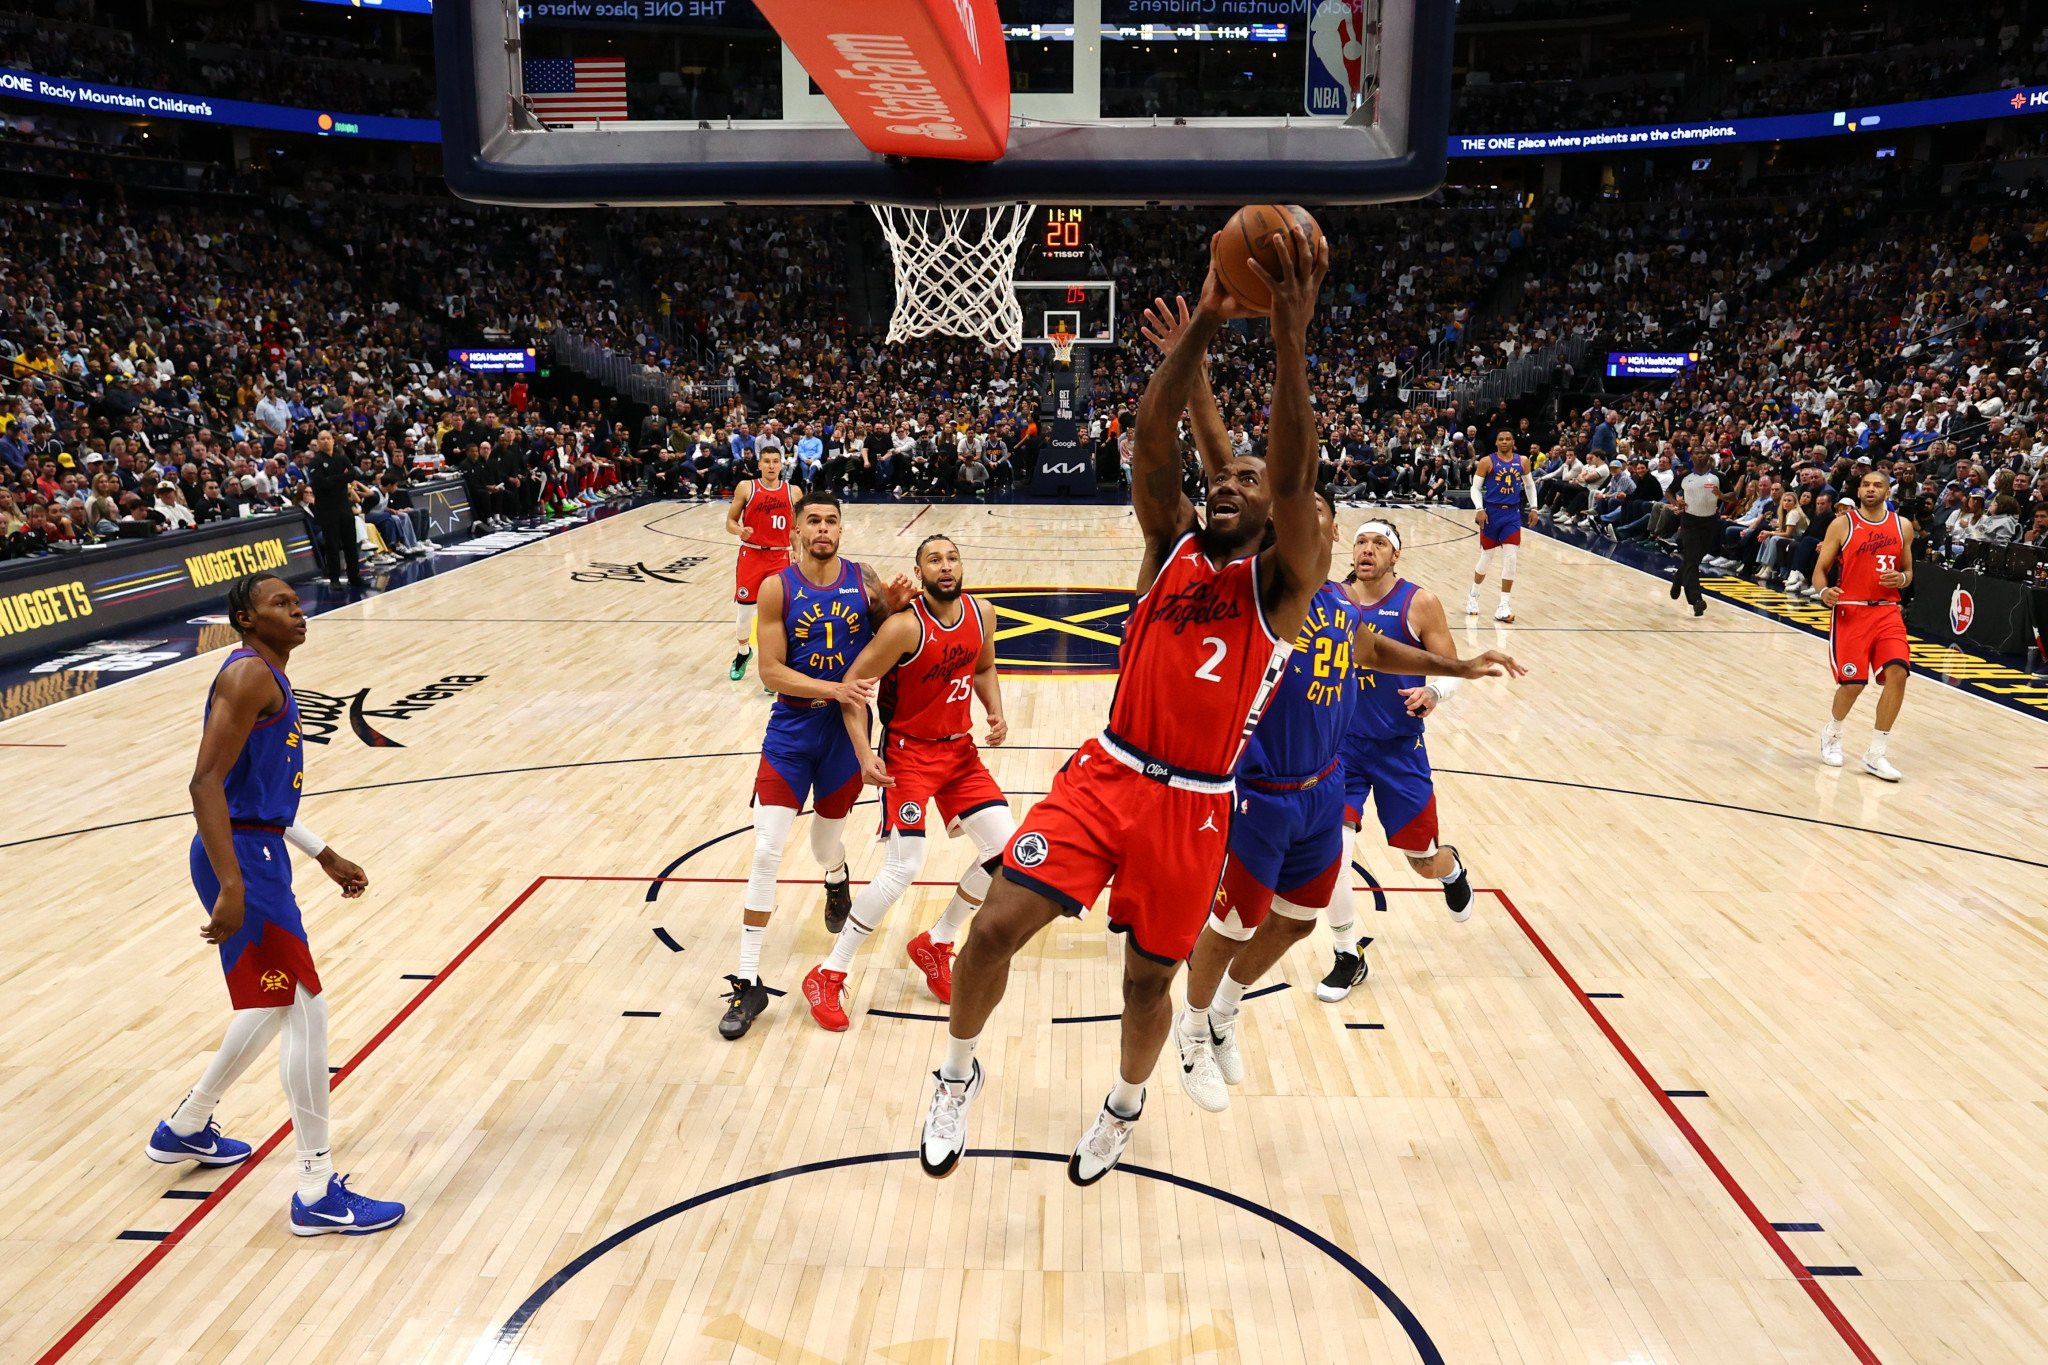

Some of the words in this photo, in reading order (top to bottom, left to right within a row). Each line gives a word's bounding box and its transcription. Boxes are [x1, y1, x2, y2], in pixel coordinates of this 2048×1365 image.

[39, 81, 77, 102] Rocky
[79, 88, 145, 108] Mountain
[148, 97, 213, 116] Children's
[1313, 87, 1340, 109] NBA
[1461, 138, 1486, 150] THE
[1488, 138, 1515, 149] ONE
[1518, 137, 1546, 151] place
[1549, 135, 1581, 147] where
[1583, 132, 1629, 147] patients
[1630, 132, 1648, 142] are
[1650, 129, 1670, 141] the
[1671, 126, 1737, 143] champions.
[1049, 209, 1082, 222] 11:14
[1047, 222, 1079, 246] 20
[1060, 390, 1070, 399] GET
[1060, 400, 1070, 409] THE
[1052, 440, 1077, 448] Google
[1505, 475, 1511, 486] 4
[771, 515, 786, 530] 10
[1856, 536, 1898, 556] Angeles
[1868, 531, 1885, 543] Los
[185, 537, 288, 588] NUGGETS.COM
[1875, 555, 1896, 572] 33
[0, 581, 93, 638] NUGGETS
[794, 603, 825, 639] MILE
[831, 601, 860, 634] HIGH
[1150, 594, 1242, 636] Angeles
[824, 621, 833, 649] 1
[1293, 607, 1331, 653] MILE
[1334, 608, 1354, 647] HIG
[809, 651, 845, 670] CITY
[921, 648, 978, 684] Angele
[942, 643, 964, 665] Los
[1194, 636, 1228, 683] 2
[1313, 637, 1350, 680] 24
[946, 674, 971, 704] 25
[1306, 680, 1344, 707] CITY
[1357, 673, 1377, 691] TY
[361, 674, 490, 721] Arena
[1146, 763, 1169, 777] Clips
[805, 978, 822, 1007] AIR
